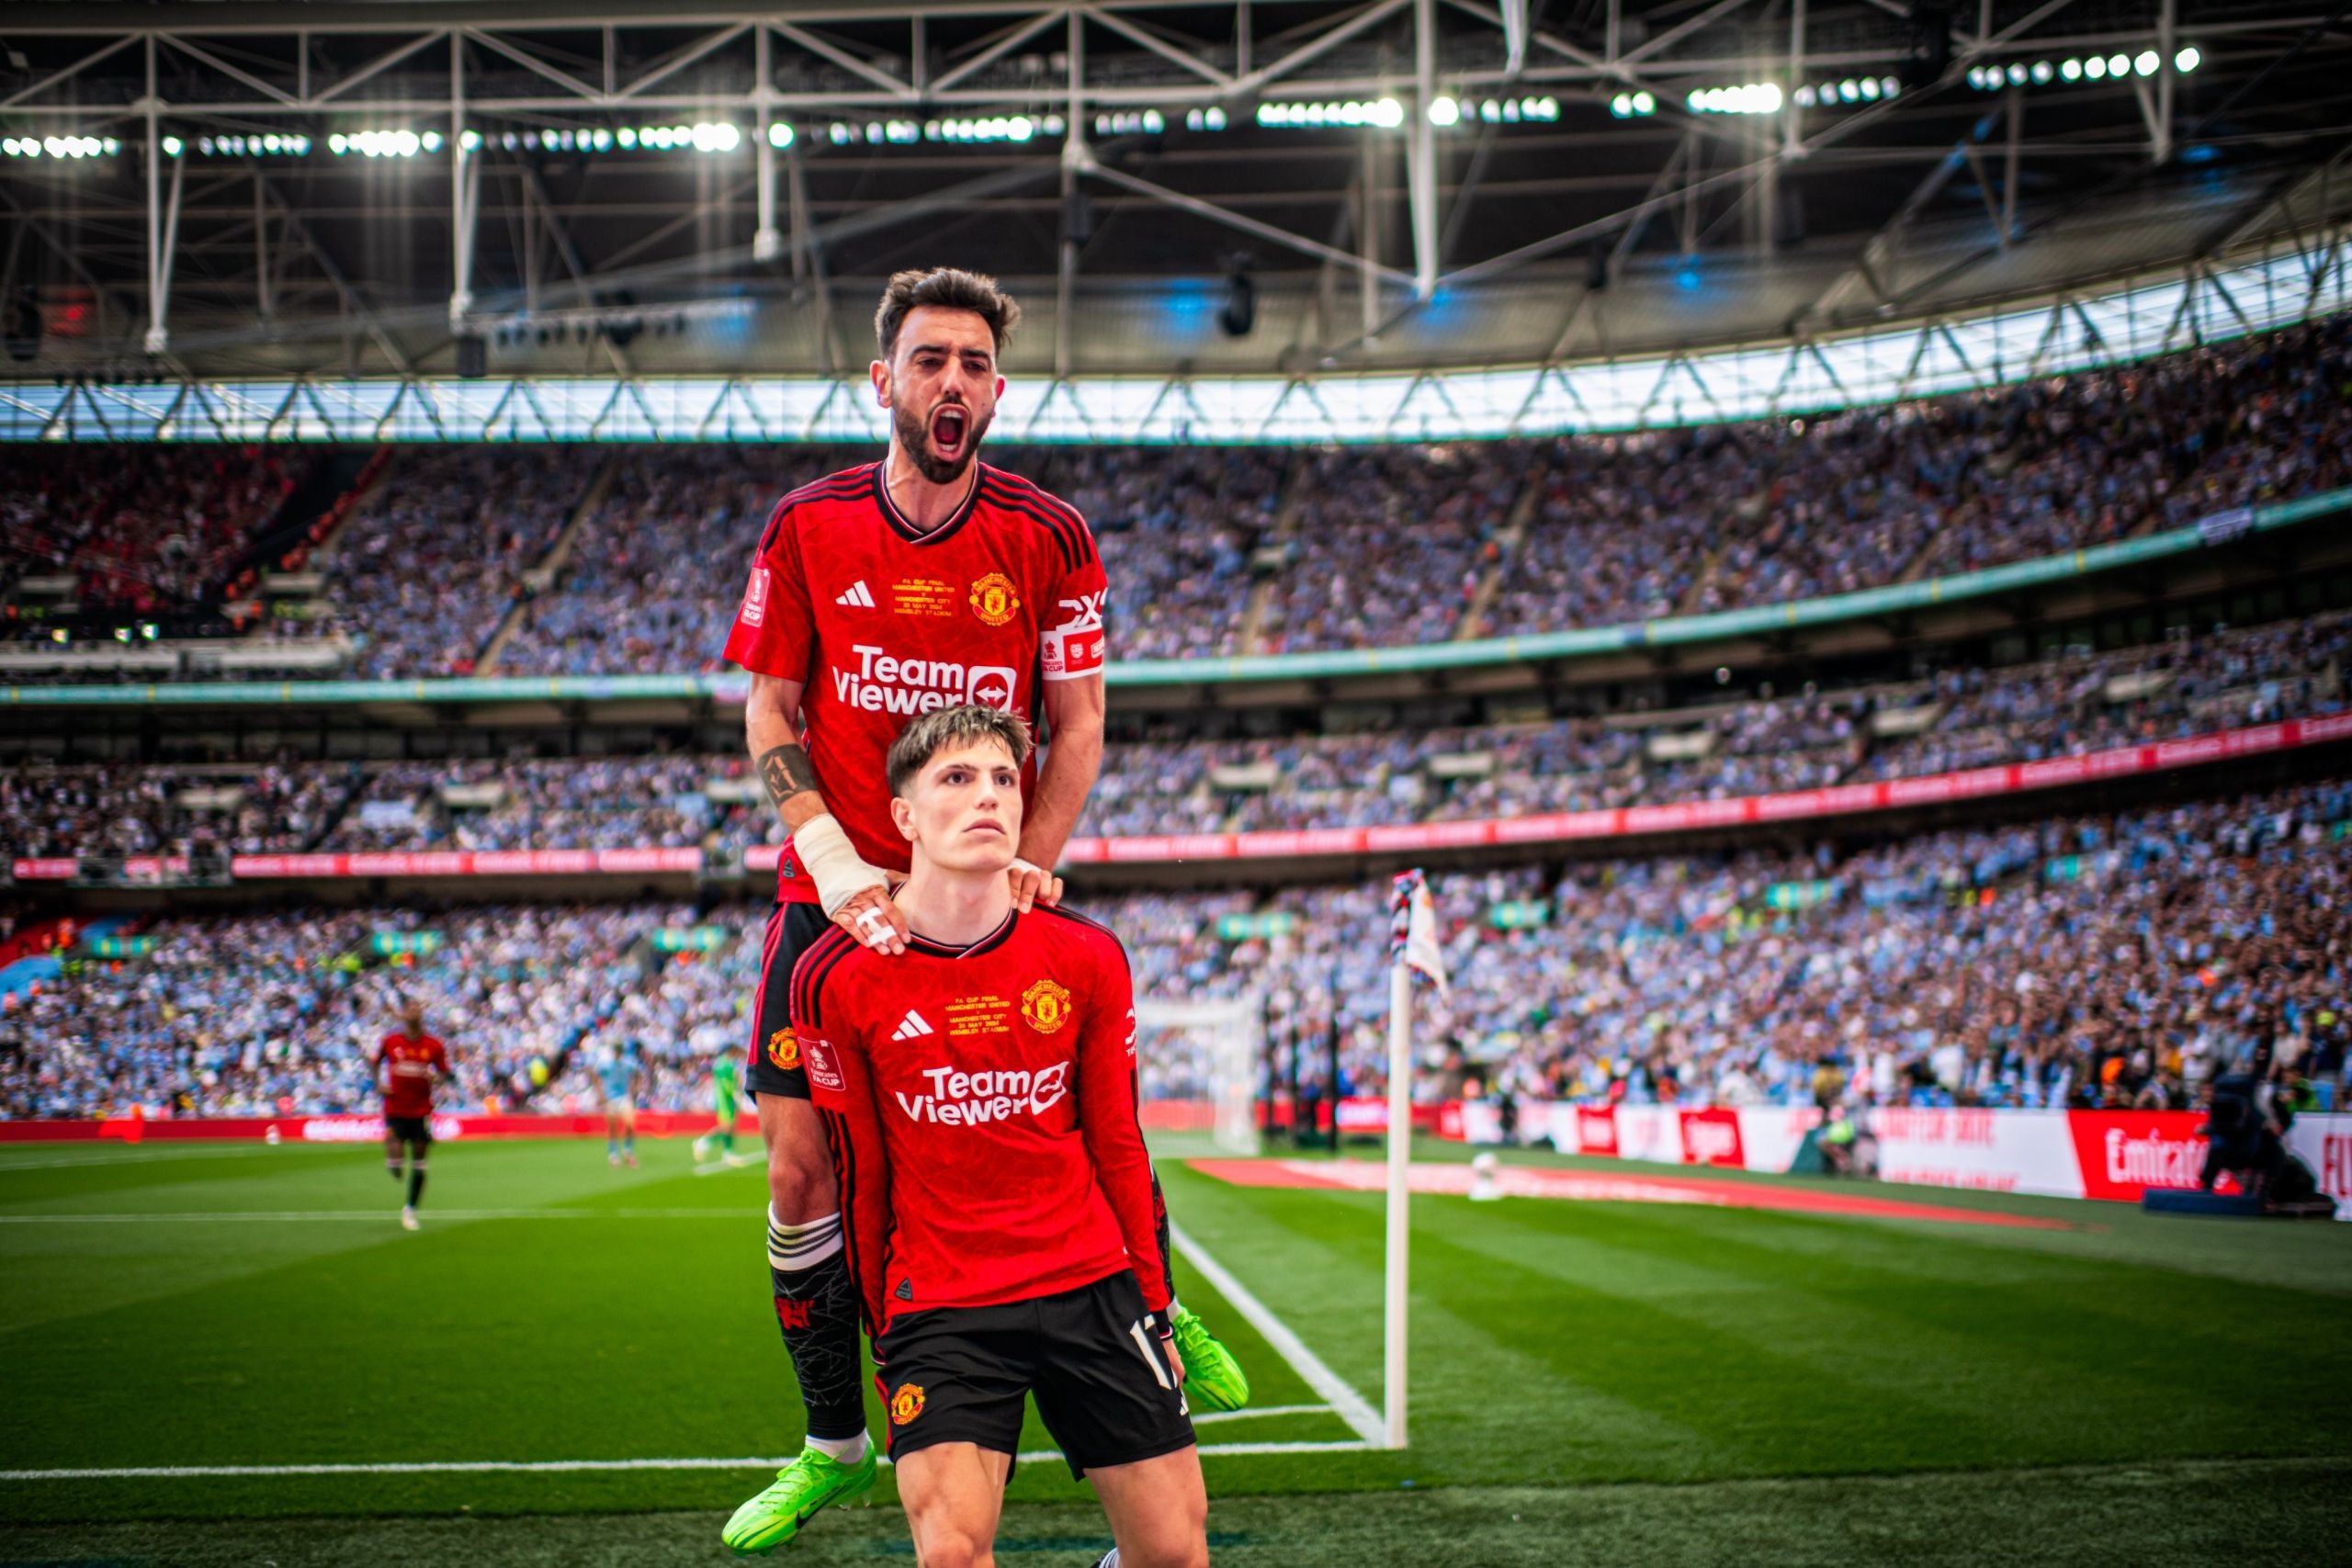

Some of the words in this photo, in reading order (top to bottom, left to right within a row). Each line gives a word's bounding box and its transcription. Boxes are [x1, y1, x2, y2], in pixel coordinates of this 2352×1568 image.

[974, 576, 1015, 594] MANCHESTER
[980, 613, 1009, 623] UNITED
[852, 644, 964, 690] Team
[832, 665, 963, 715] Viewer
[1026, 984, 1067, 1000] MANCHESTER
[945, 1002, 987, 1011] MANCHESTER
[949, 1014, 991, 1023] MANCHESTER
[1034, 1021, 1062, 1030] UNITED
[813, 1075, 822, 1083] FA
[821, 1077, 840, 1086] CUP
[922, 1066, 1031, 1100] Team
[895, 1091, 1029, 1126] Viewer
[2105, 1128, 2212, 1188] Emirat
